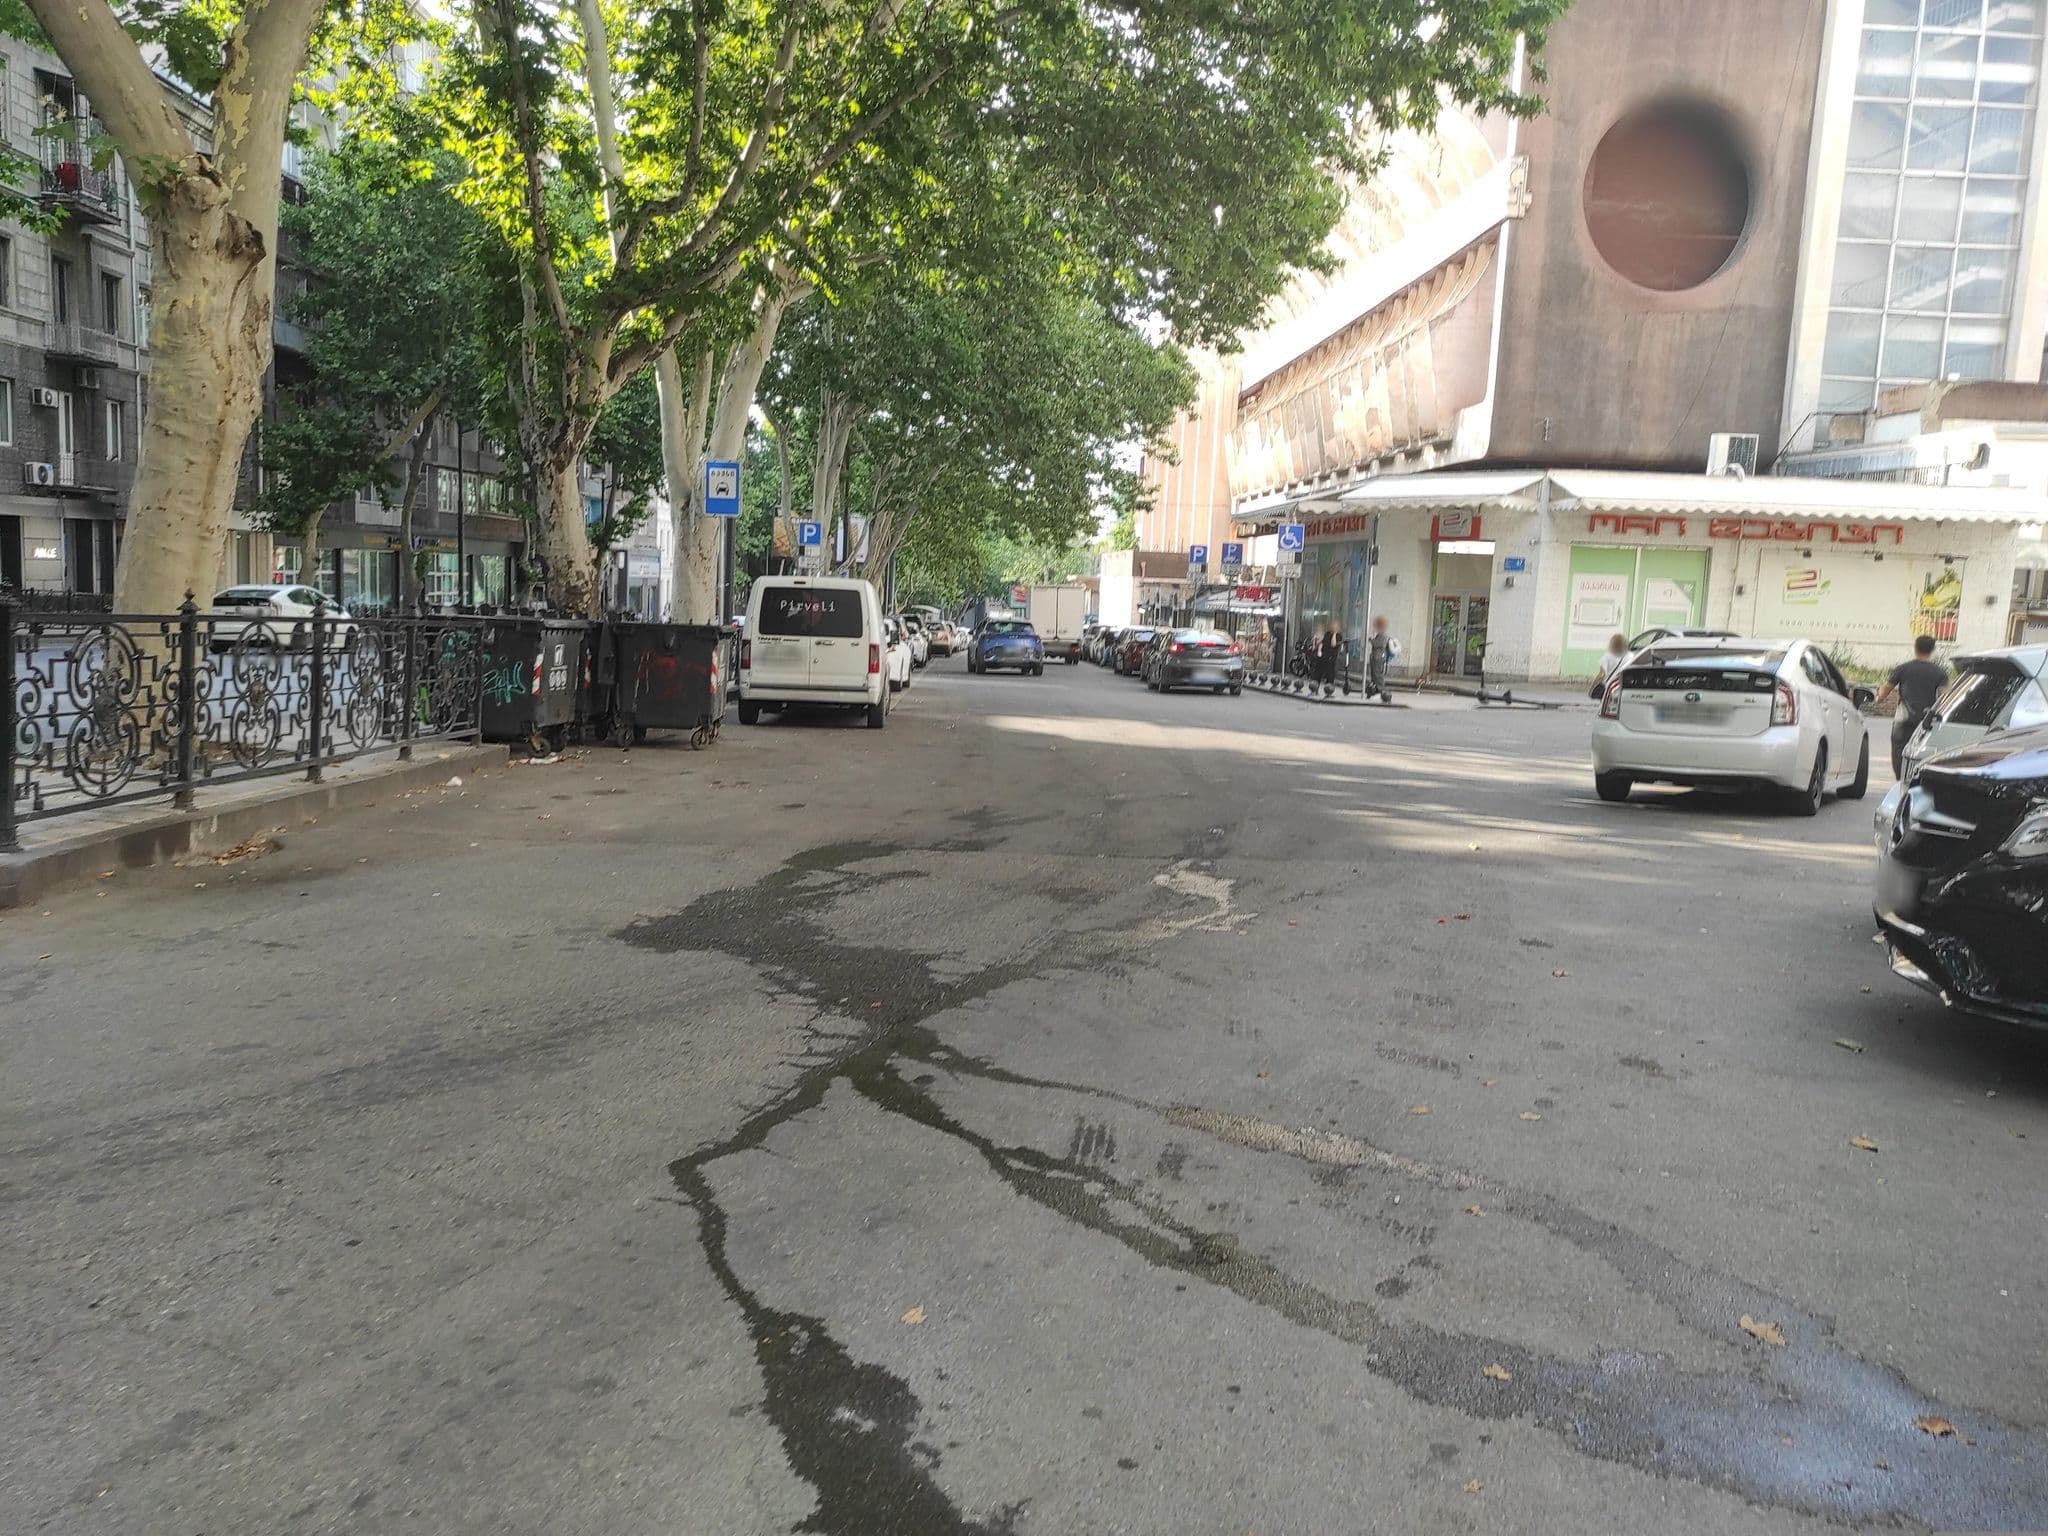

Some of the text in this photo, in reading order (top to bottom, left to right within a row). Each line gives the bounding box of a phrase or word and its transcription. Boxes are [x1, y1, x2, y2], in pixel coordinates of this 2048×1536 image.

[804, 525, 817, 542] P
[1193, 547, 1204, 562] P
[780, 599, 836, 612] Pirveli
